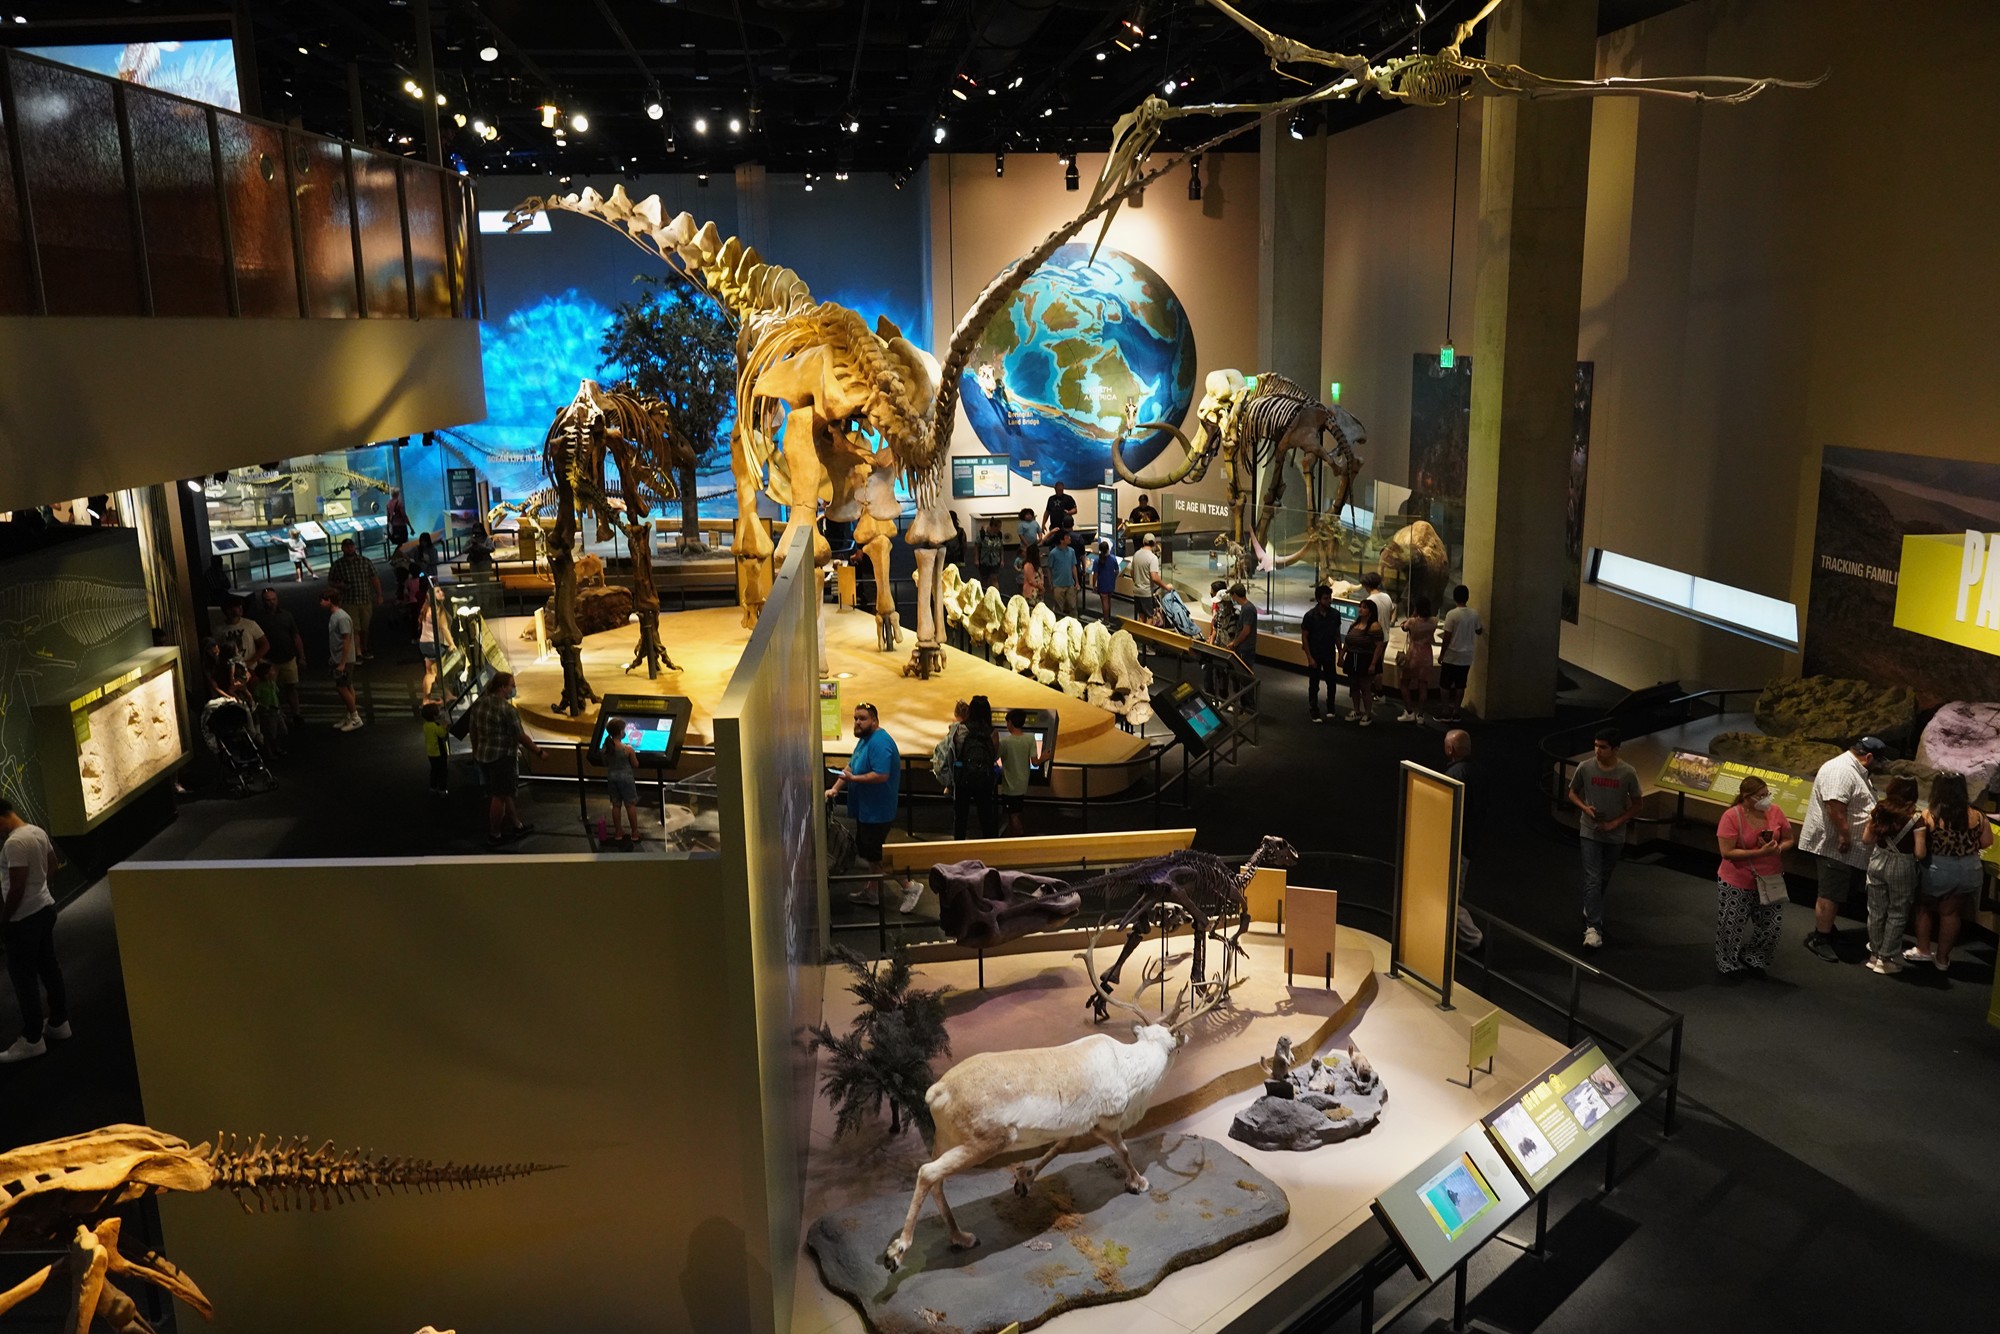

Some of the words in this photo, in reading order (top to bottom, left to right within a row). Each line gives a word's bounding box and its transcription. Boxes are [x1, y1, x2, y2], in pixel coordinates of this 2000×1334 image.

[1175, 500, 1185, 511] ICE
[1186, 501, 1198, 513] AGE
[1200, 503, 1206, 513] IN
[1208, 504, 1228, 516] TEXAS
[1821, 554, 1864, 577] TRACKING
[1723, 761, 1748, 774] FOLLOWING
[1765, 770, 1790, 783] FOOTSTEPS
